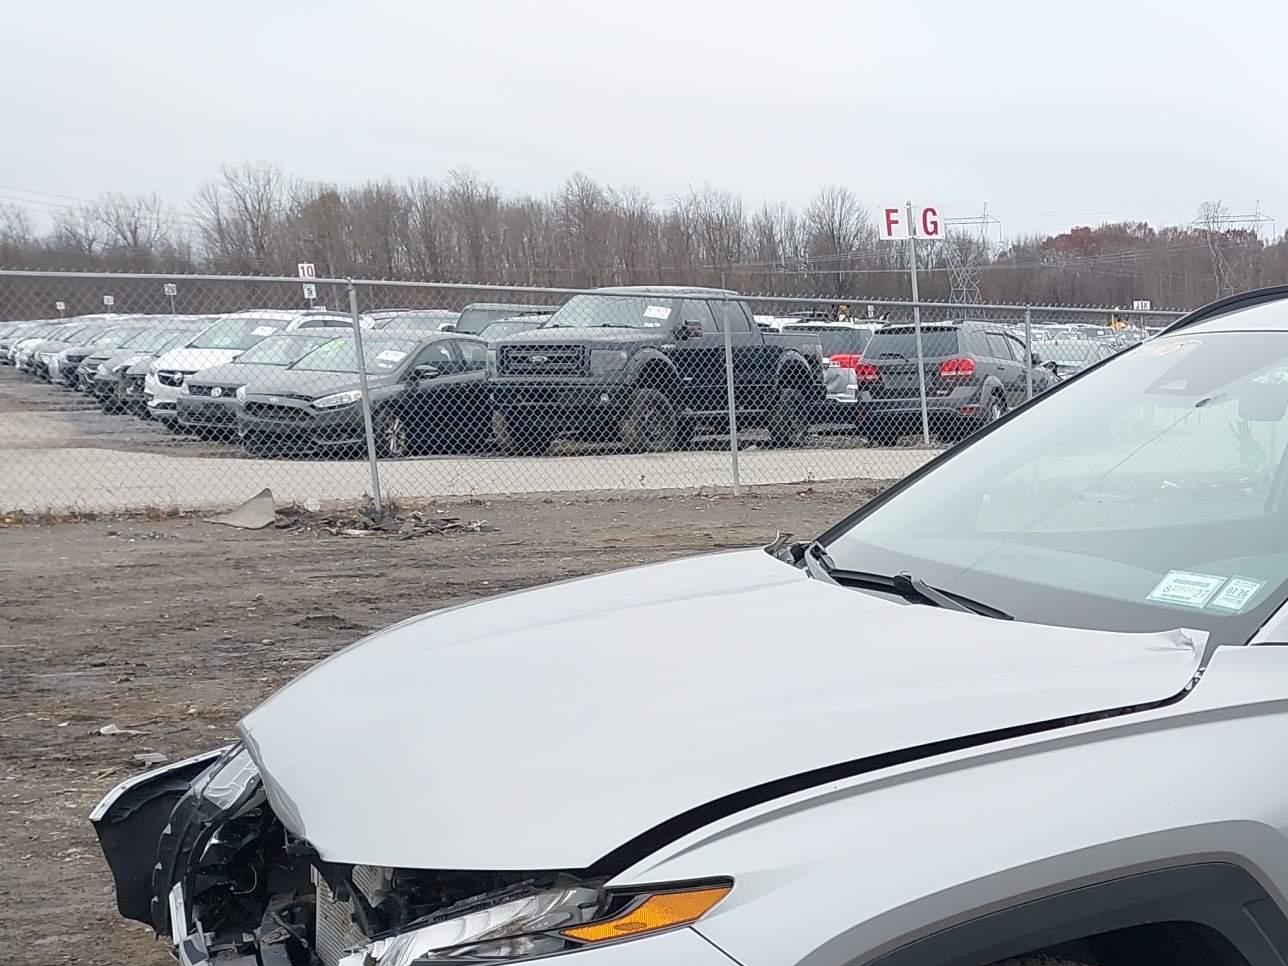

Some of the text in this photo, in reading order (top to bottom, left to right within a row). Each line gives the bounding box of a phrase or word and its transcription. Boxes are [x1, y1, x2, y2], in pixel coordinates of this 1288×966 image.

[884, 207, 939, 237] F G
[300, 265, 314, 277] 10
